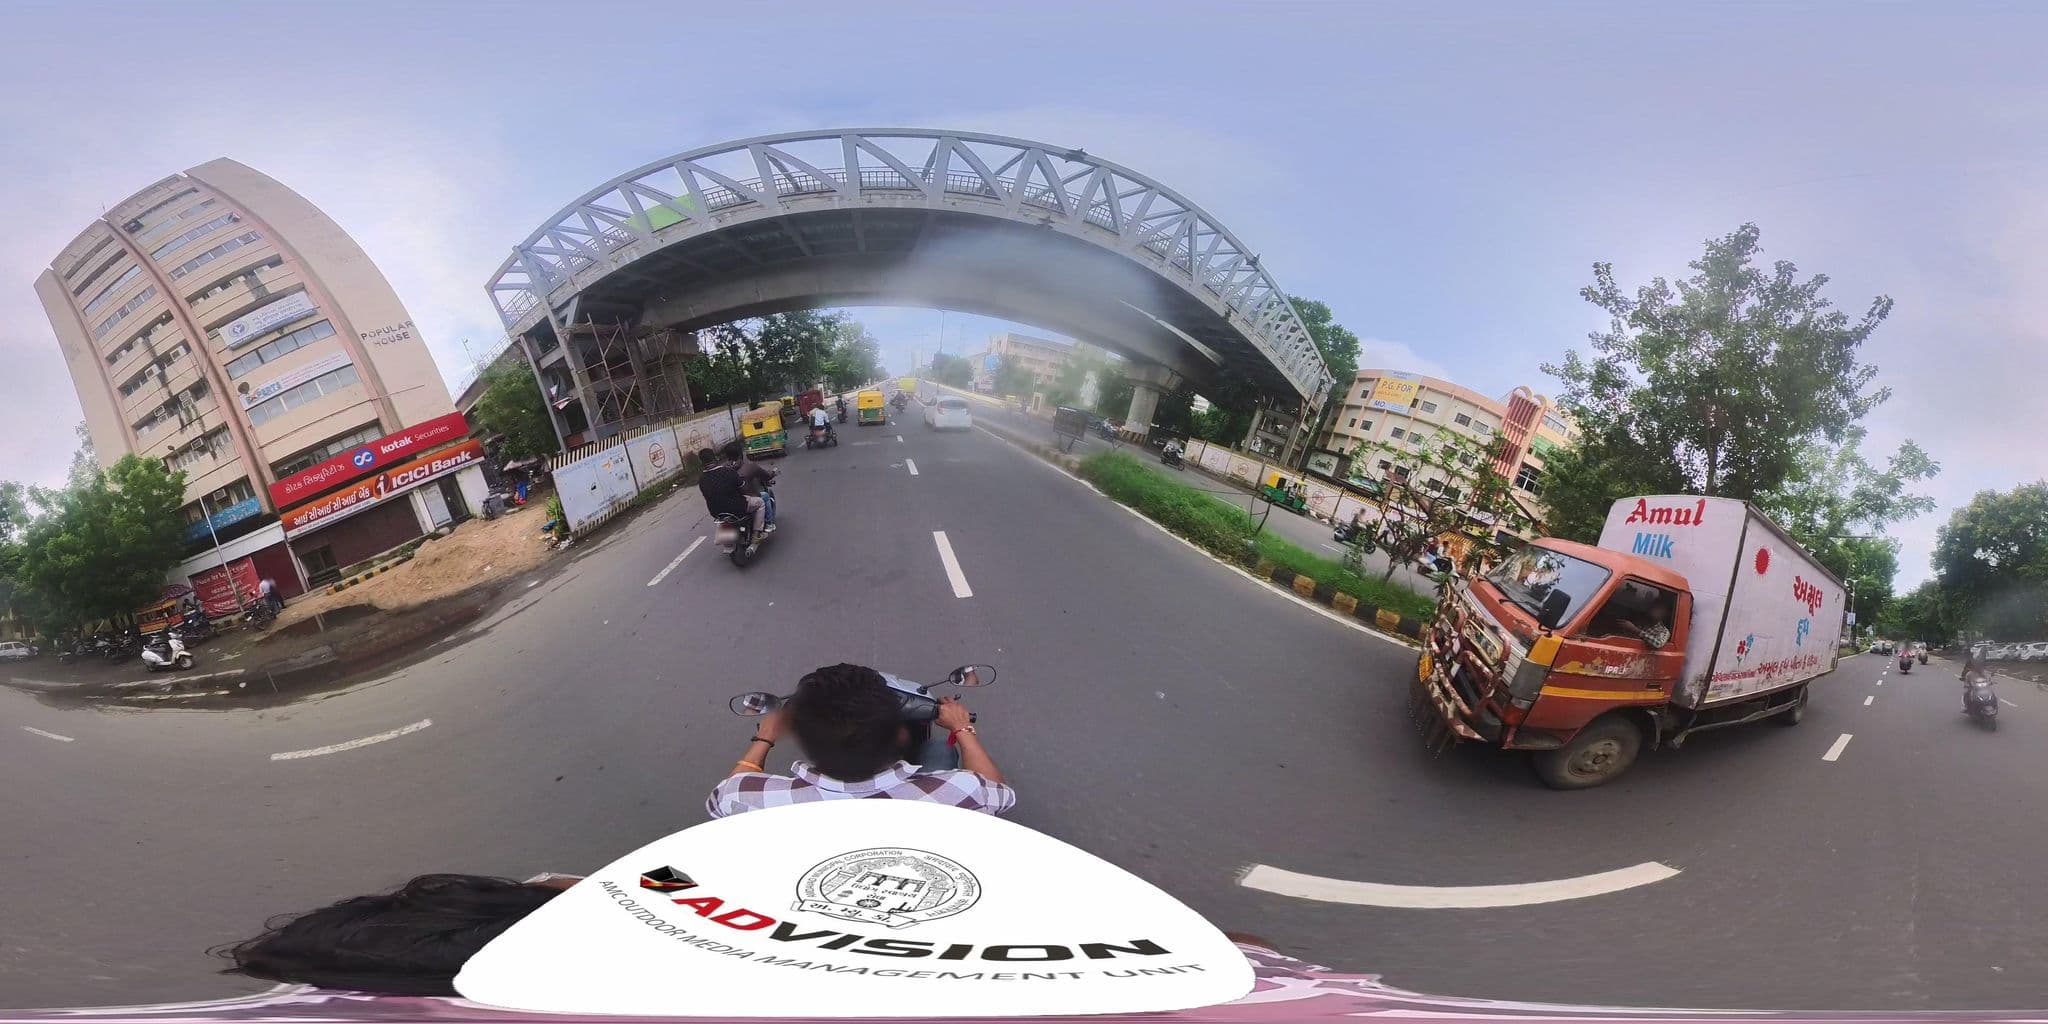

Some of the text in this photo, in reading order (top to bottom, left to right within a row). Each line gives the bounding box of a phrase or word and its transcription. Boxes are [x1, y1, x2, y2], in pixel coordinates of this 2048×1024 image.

[361, 320, 415, 340] POPULAR
[381, 424, 450, 455] kotak Securities
[392, 463, 430, 490] ICICI
[432, 450, 472, 472] Bank
[1625, 498, 1706, 527] Amul
[1632, 532, 1675, 559] Milk
[1793, 575, 1824, 616] અમૂલ
[1796, 618, 1810, 647] દૂધ
